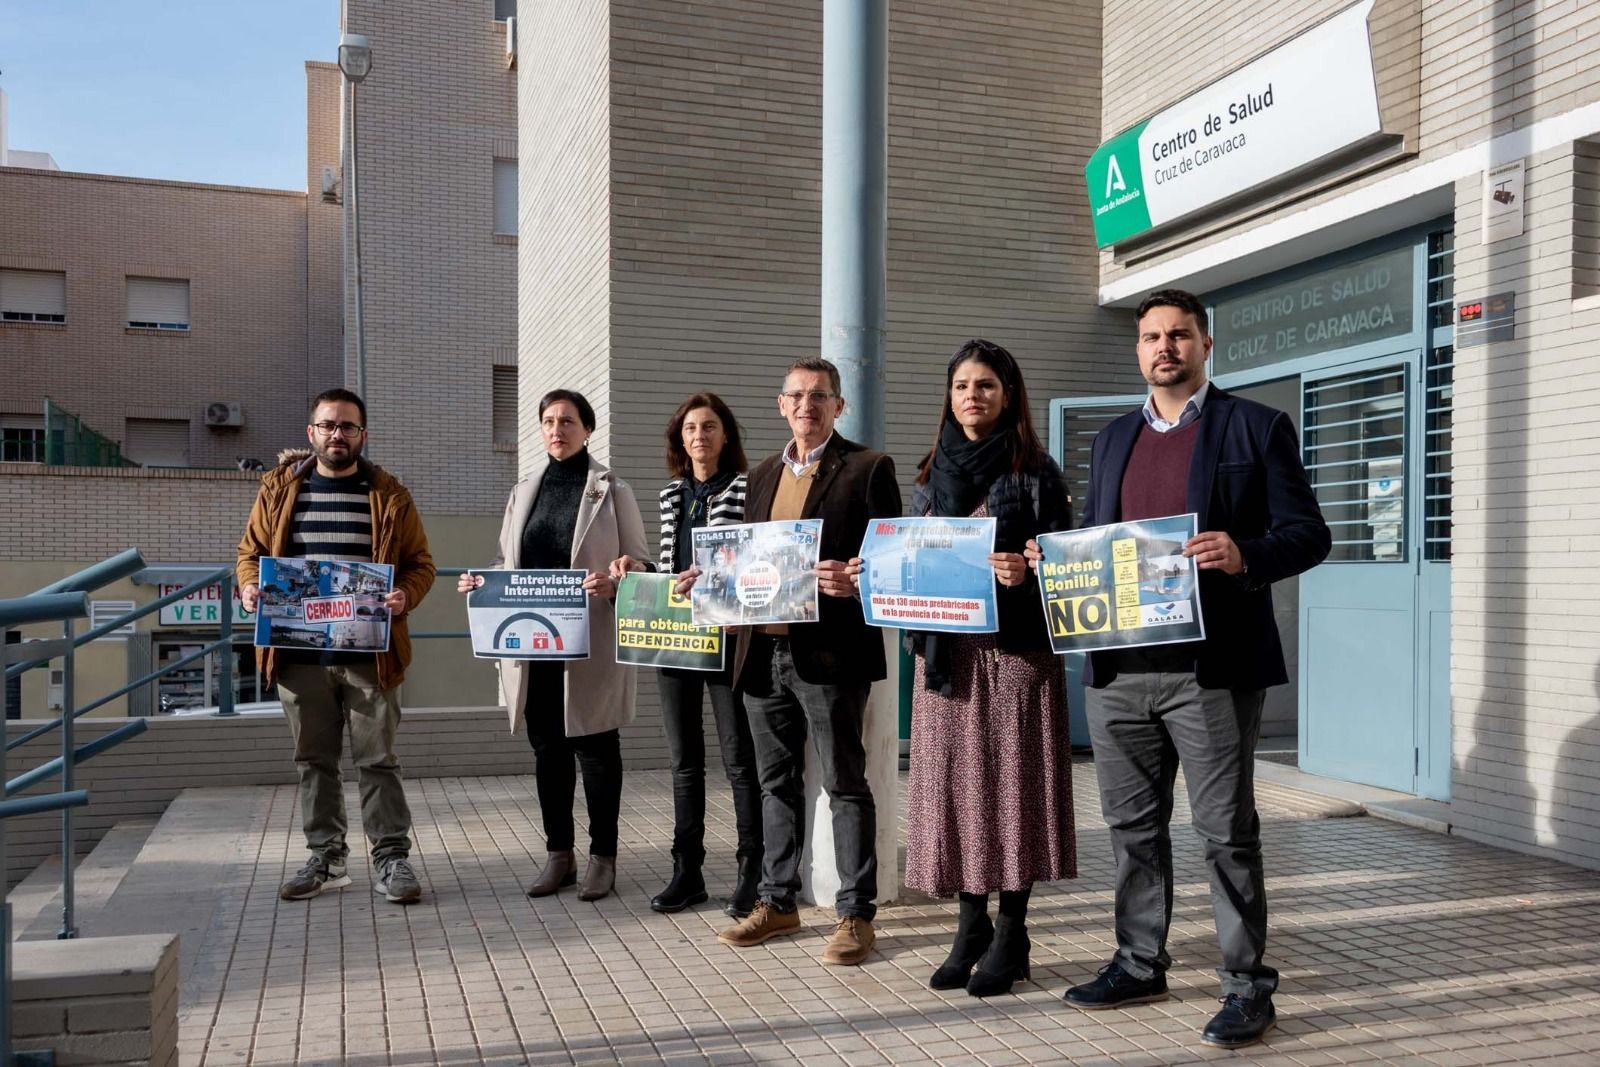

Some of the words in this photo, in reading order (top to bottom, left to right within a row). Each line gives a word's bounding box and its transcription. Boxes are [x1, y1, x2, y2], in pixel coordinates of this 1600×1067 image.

[1152, 128, 1196, 162] Centro
[1204, 114, 1222, 136] de
[1228, 83, 1274, 124] Salud
[1154, 165, 1178, 185] Cruz
[1180, 156, 1192, 174] de
[1194, 133, 1246, 166] Caravaca
[1096, 204, 1108, 216] Junta
[1109, 200, 1116, 209] de
[1116, 188, 1140, 206] Andalucía
[1232, 294, 1294, 329] CENTRO
[1301, 286, 1323, 310] DE
[1332, 268, 1391, 302] SALUD
[1228, 335, 1268, 362] CRUZ
[1276, 327, 1297, 350] DE
[1304, 304, 1394, 343] CARAVACA
[696, 532, 724, 541] COLAS
[876, 522, 896, 536] Más
[924, 538, 952, 549] nunca
[1042, 558, 1103, 577] Moreno
[510, 575, 582, 585] Entrevistas
[1045, 574, 1100, 592] Bonilla
[504, 585, 582, 596] Interalmería
[306, 600, 351, 620] CERRADO
[872, 597, 886, 605] más
[887, 597, 895, 605] de
[896, 598, 908, 606] 130
[909, 598, 928, 607] aulas
[930, 599, 980, 610] prefabricadas
[898, 609, 930, 619] provincia
[932, 610, 940, 619] de
[942, 611, 969, 621] Almería
[1050, 596, 1108, 634] NO
[619, 618, 645, 629] para
[537, 639, 543, 648] 1
[620, 634, 715, 650] DEPENDENCIA
